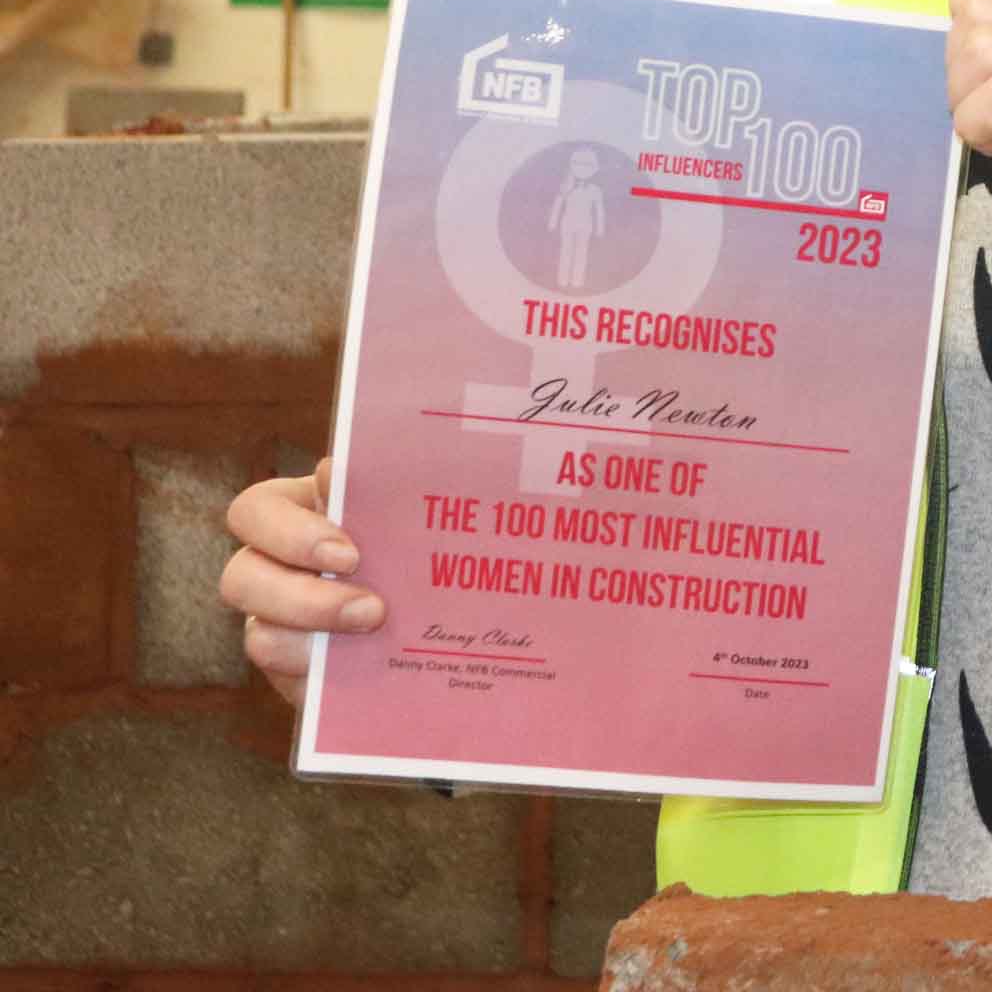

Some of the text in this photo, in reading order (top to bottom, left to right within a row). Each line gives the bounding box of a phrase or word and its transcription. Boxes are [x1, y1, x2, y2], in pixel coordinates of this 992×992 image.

[481, 71, 544, 102] NFB
[637, 58, 862, 207] TOP 100
[637, 152, 743, 182] INFLUENCERS
[796, 222, 882, 269] 2023
[523, 299, 777, 358] THIS RECOGNISES
[517, 378, 758, 430] Julie Newton
[556, 450, 708, 497] AS ONE OF
[423, 494, 825, 565] THE 100 MOST INFLUENTIAL
[431, 552, 807, 620] WOMEN IN CONSTRUCTION
[389, 658, 423, 672] Danny
[492, 666, 557, 681] Commercial
[448, 678, 494, 691] Director
[730, 653, 777, 668] October
[780, 657, 809, 670] 2023
[744, 688, 770, 699] Date
